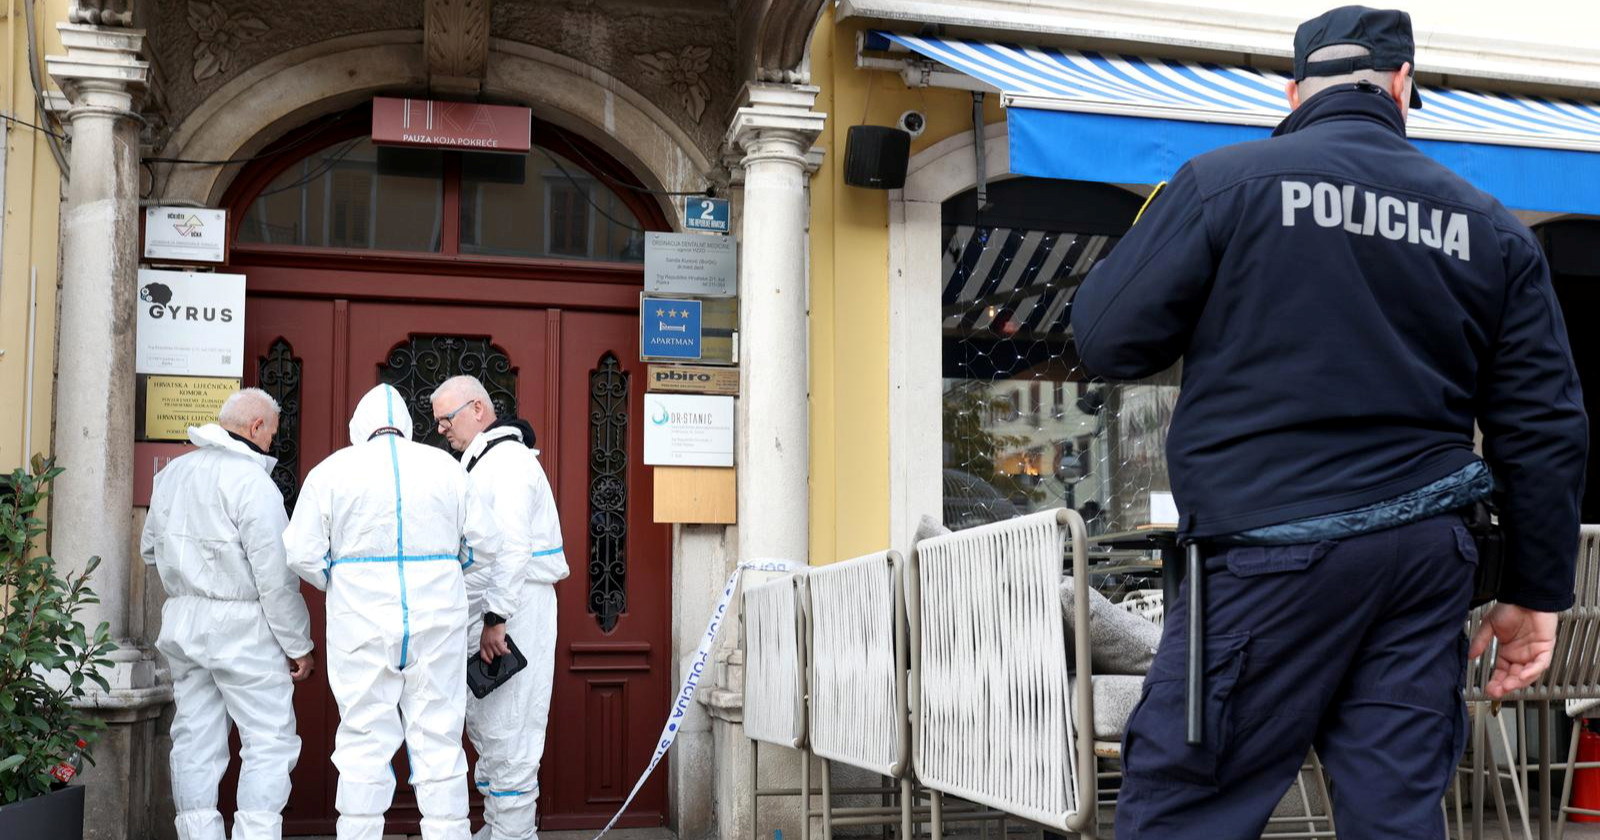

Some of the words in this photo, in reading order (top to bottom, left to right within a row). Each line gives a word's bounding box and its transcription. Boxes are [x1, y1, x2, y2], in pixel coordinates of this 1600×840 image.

[403, 134, 432, 143] PAUZA
[433, 136, 456, 145] KOJA
[457, 137, 498, 148] POKREĆE
[701, 200, 715, 220] 2
[1281, 180, 1470, 261] POLICIJA
[149, 304, 233, 323] GYRUS
[651, 337, 694, 346] APARTMAN
[656, 371, 711, 382] pbiro
[672, 650, 707, 719] POLICIJA
